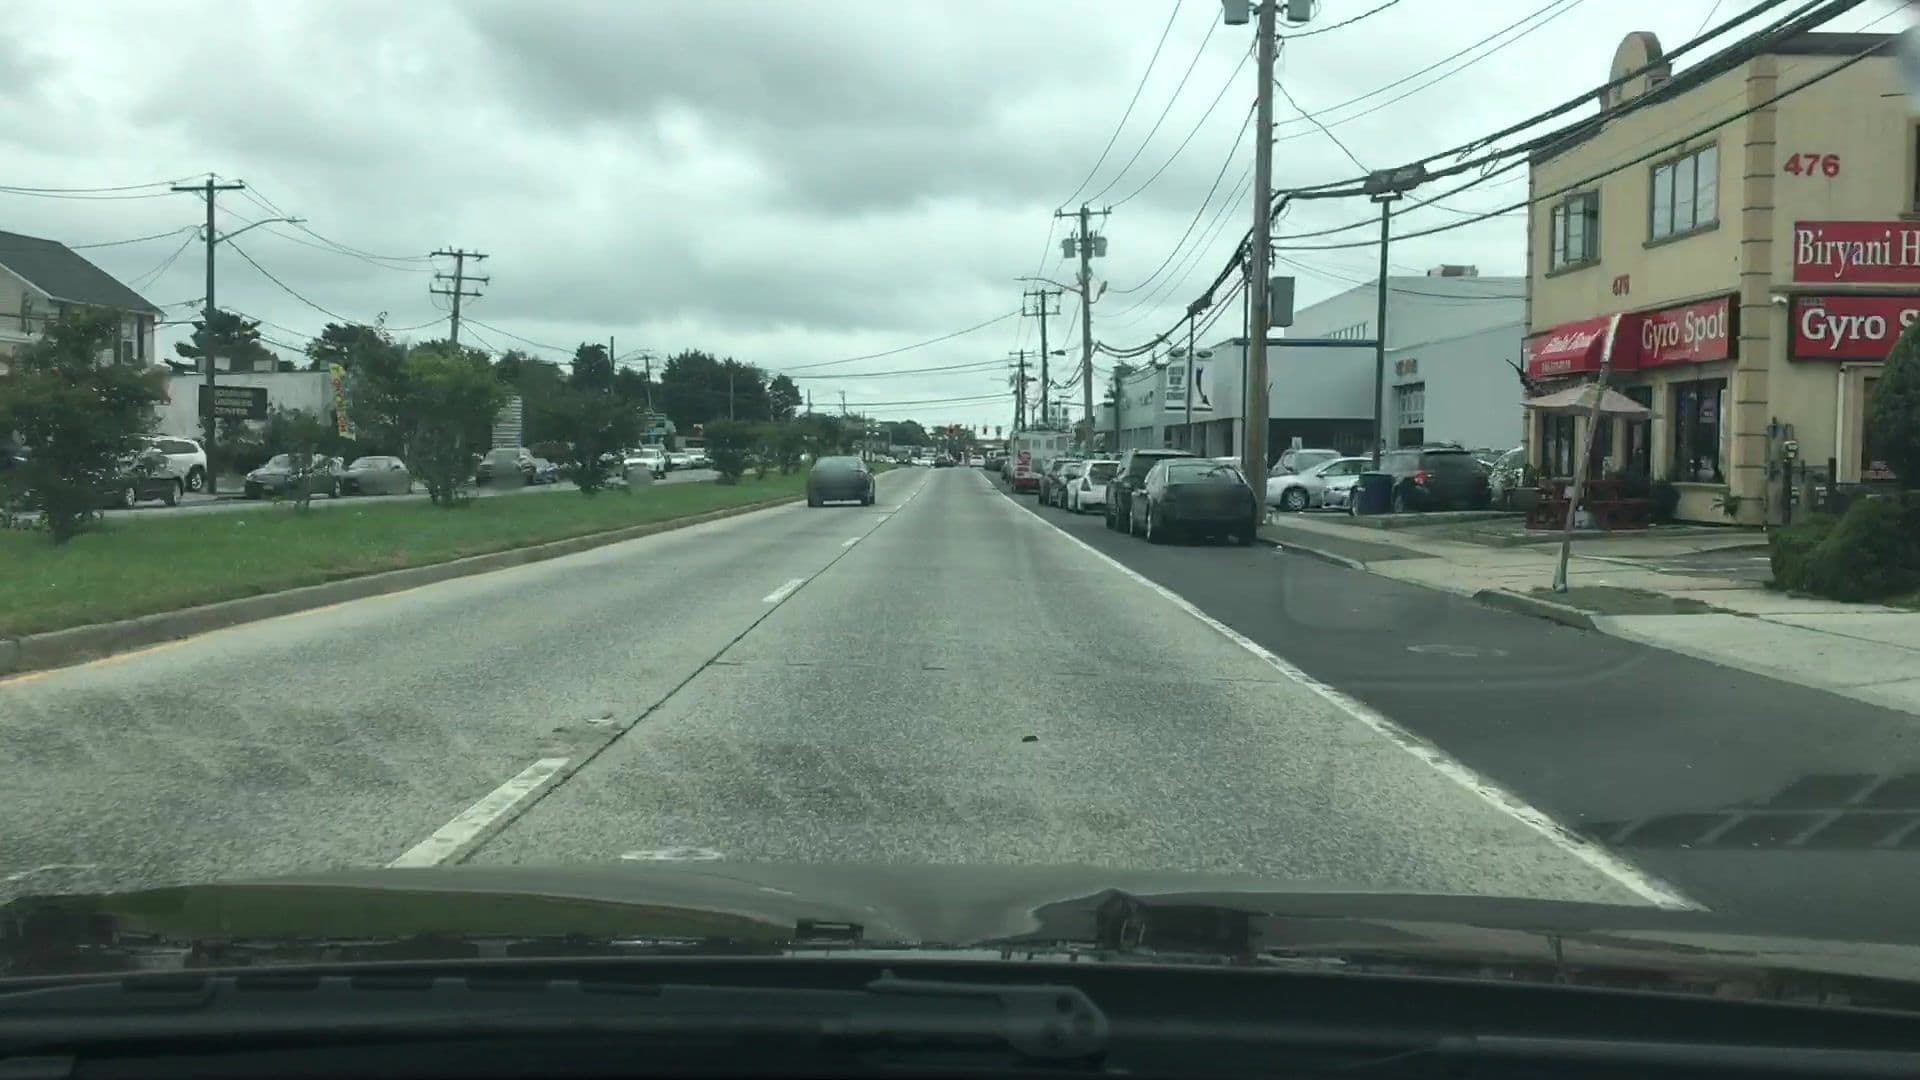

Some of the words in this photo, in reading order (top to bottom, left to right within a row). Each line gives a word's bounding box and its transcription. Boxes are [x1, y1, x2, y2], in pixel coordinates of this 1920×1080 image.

[1783, 153, 1841, 177] 476
[1797, 229, 1892, 279] Biryani
[1642, 319, 1679, 358] Gyro
[1684, 307, 1725, 352] Spot
[1801, 308, 1886, 350] Gyro
